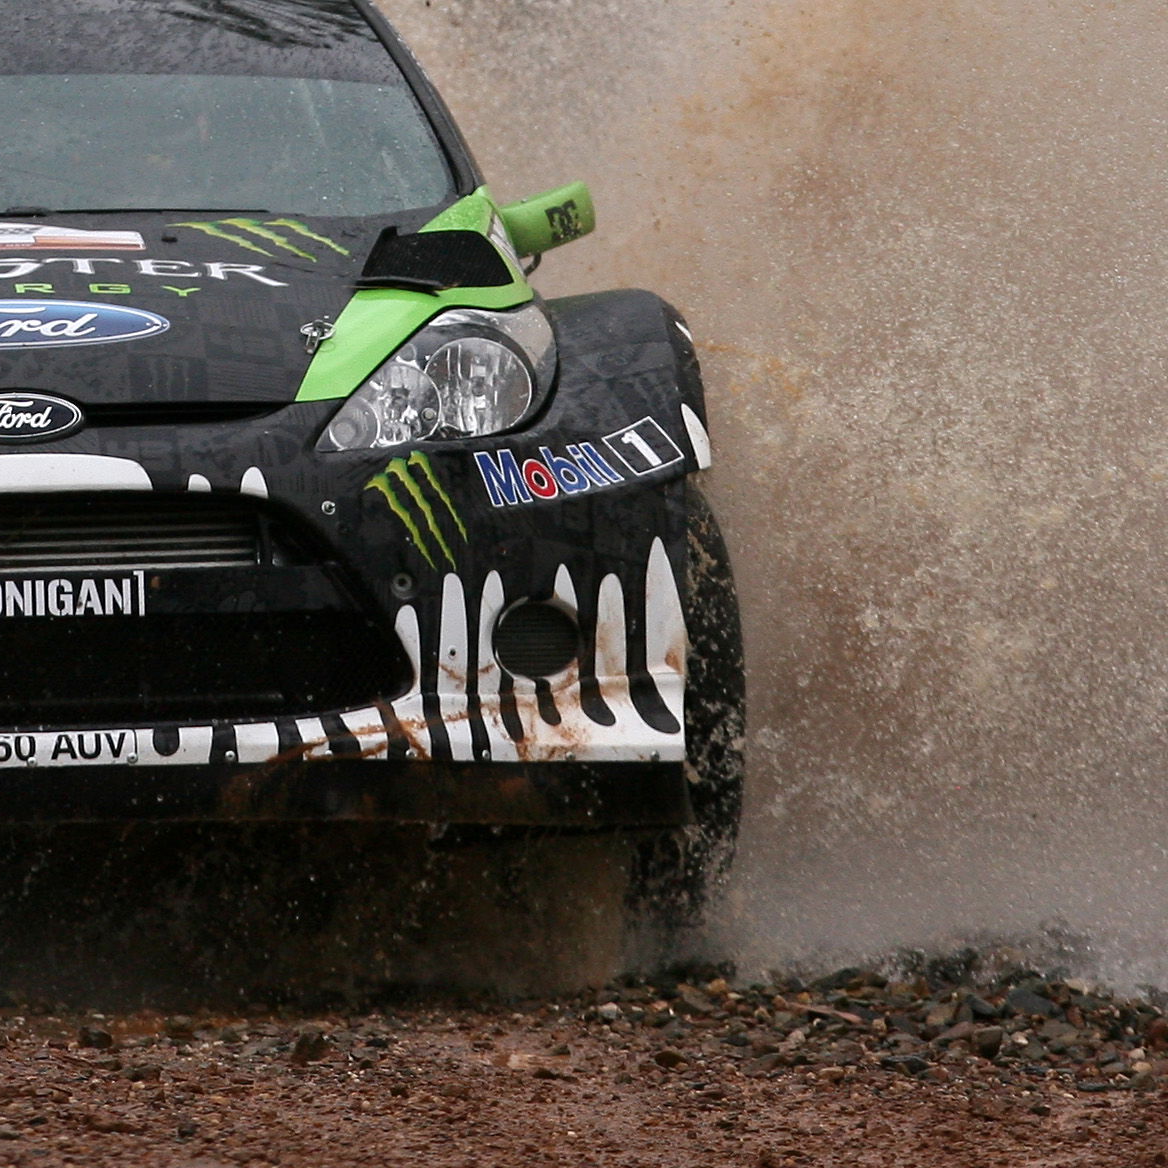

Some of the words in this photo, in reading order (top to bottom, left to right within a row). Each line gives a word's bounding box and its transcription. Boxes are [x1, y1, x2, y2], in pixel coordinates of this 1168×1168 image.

[473, 442, 625, 507] Mobil
[621, 430, 662, 466] 1
[51, 731, 127, 761] AUV
